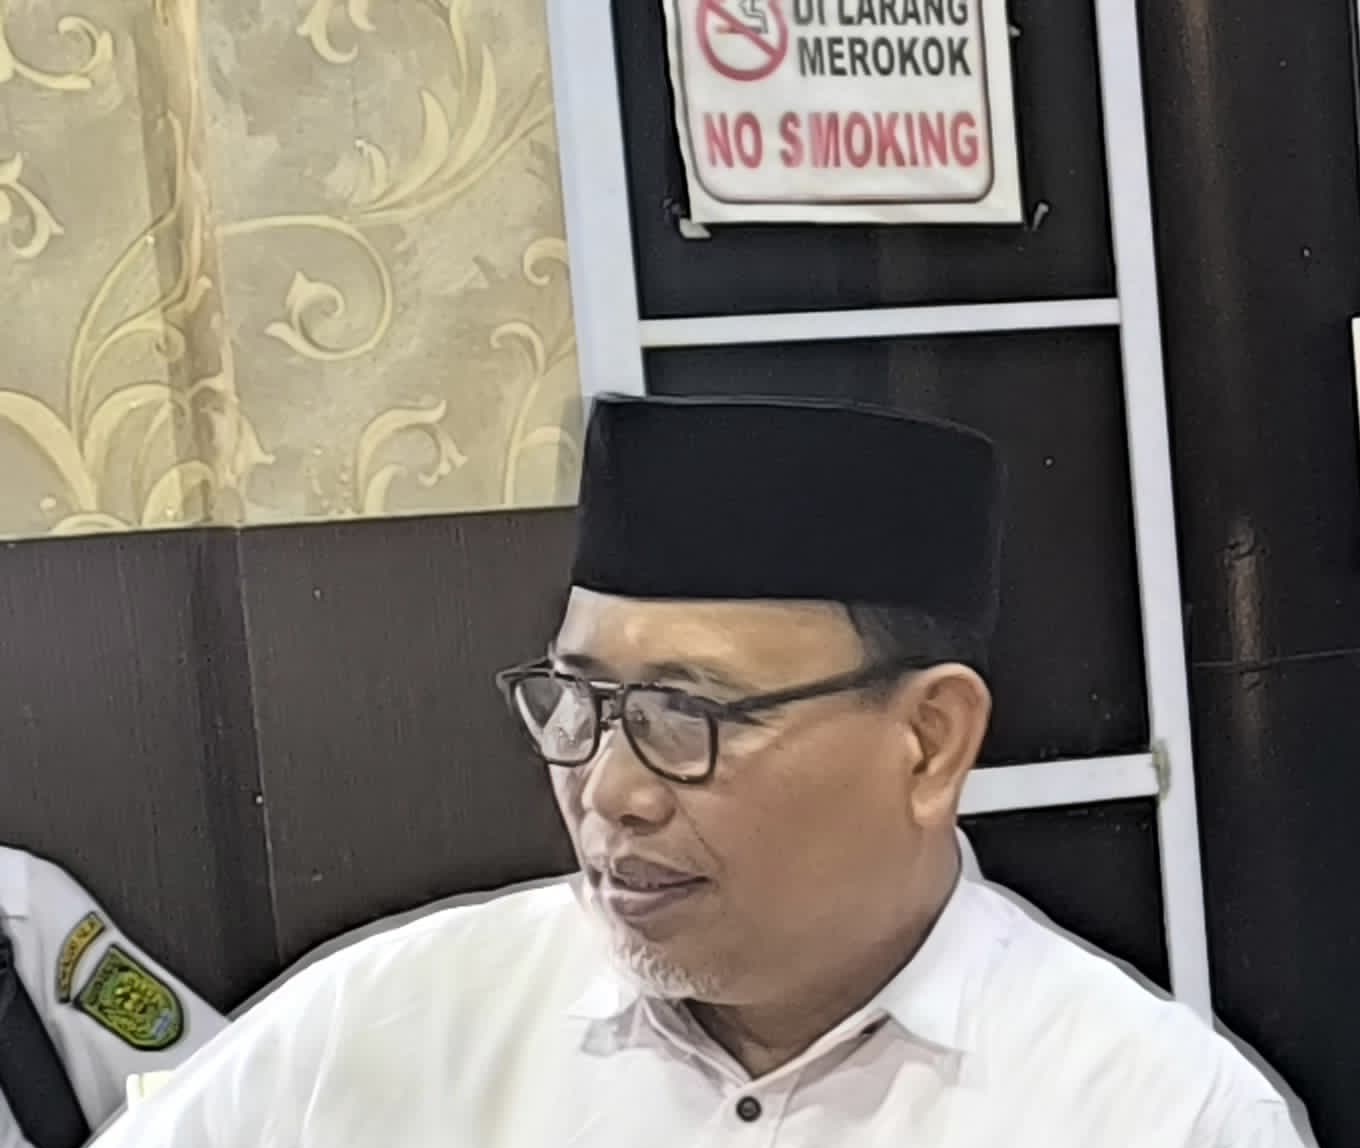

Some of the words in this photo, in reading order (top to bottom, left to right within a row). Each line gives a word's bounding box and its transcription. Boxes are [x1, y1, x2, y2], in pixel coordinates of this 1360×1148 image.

[838, 0, 968, 26] LARANG
[798, 36, 972, 77] MEROKOK
[704, 111, 763, 169] NO
[780, 111, 979, 169] SMOKING
